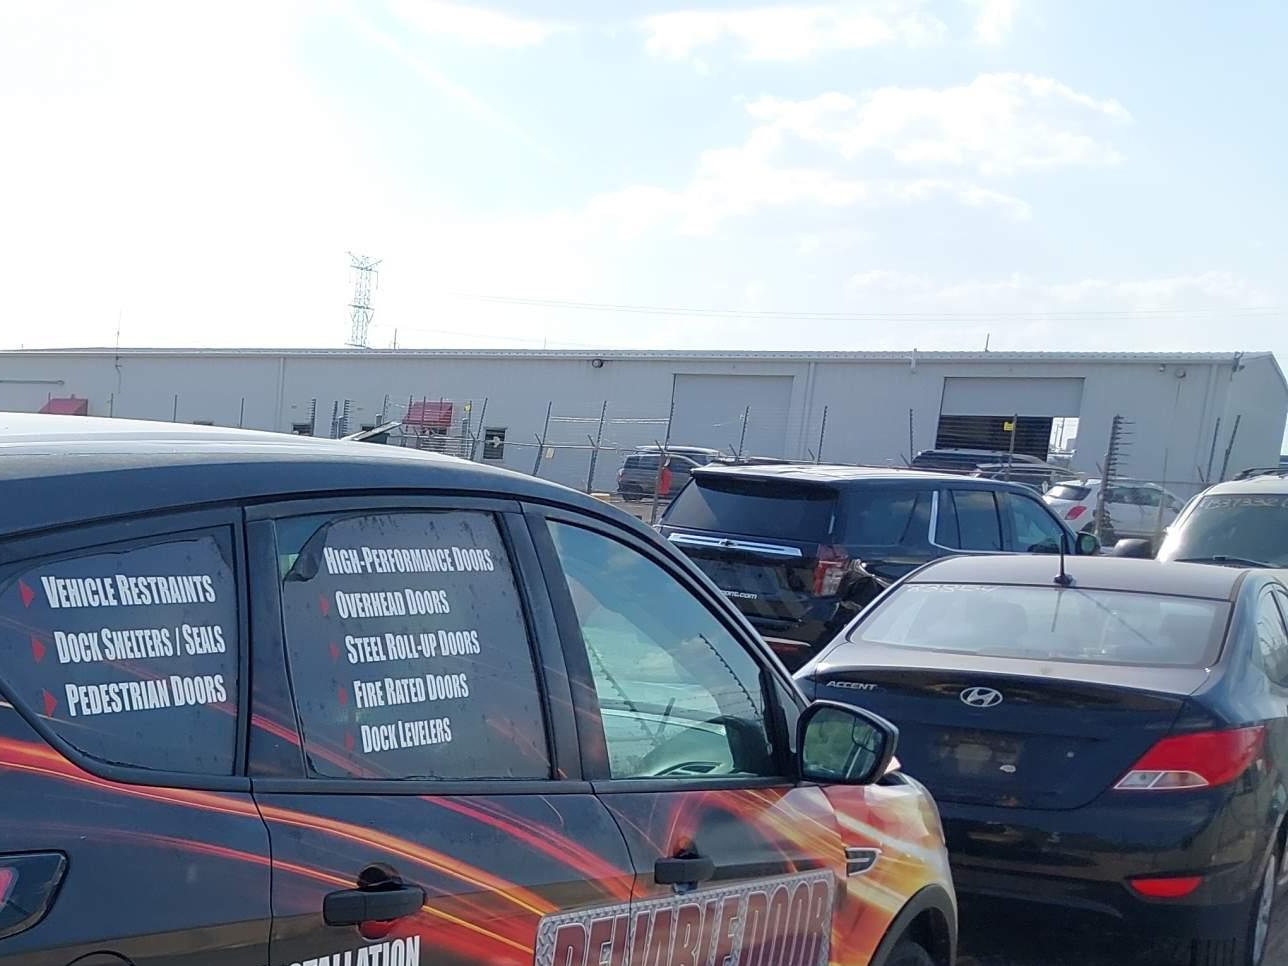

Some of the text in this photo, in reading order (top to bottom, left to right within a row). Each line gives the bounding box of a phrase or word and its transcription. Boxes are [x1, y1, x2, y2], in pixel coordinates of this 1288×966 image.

[323, 546, 495, 577] HIGH-PERFORMANCE DOORS
[41, 574, 216, 610] VEHICLE RESTRAINTS
[335, 588, 450, 619] OVERHEAD DOORS
[54, 624, 226, 664] DOCK SHELTERS / SEALS
[345, 629, 481, 666] STEEL ROLL-UP DOORS
[65, 673, 227, 718] PEDESTRIAN DOORS
[353, 673, 469, 710] FIRE RATED DOORS
[825, 680, 878, 691] ACCENT
[360, 717, 453, 754] DOCK LEVELERS
